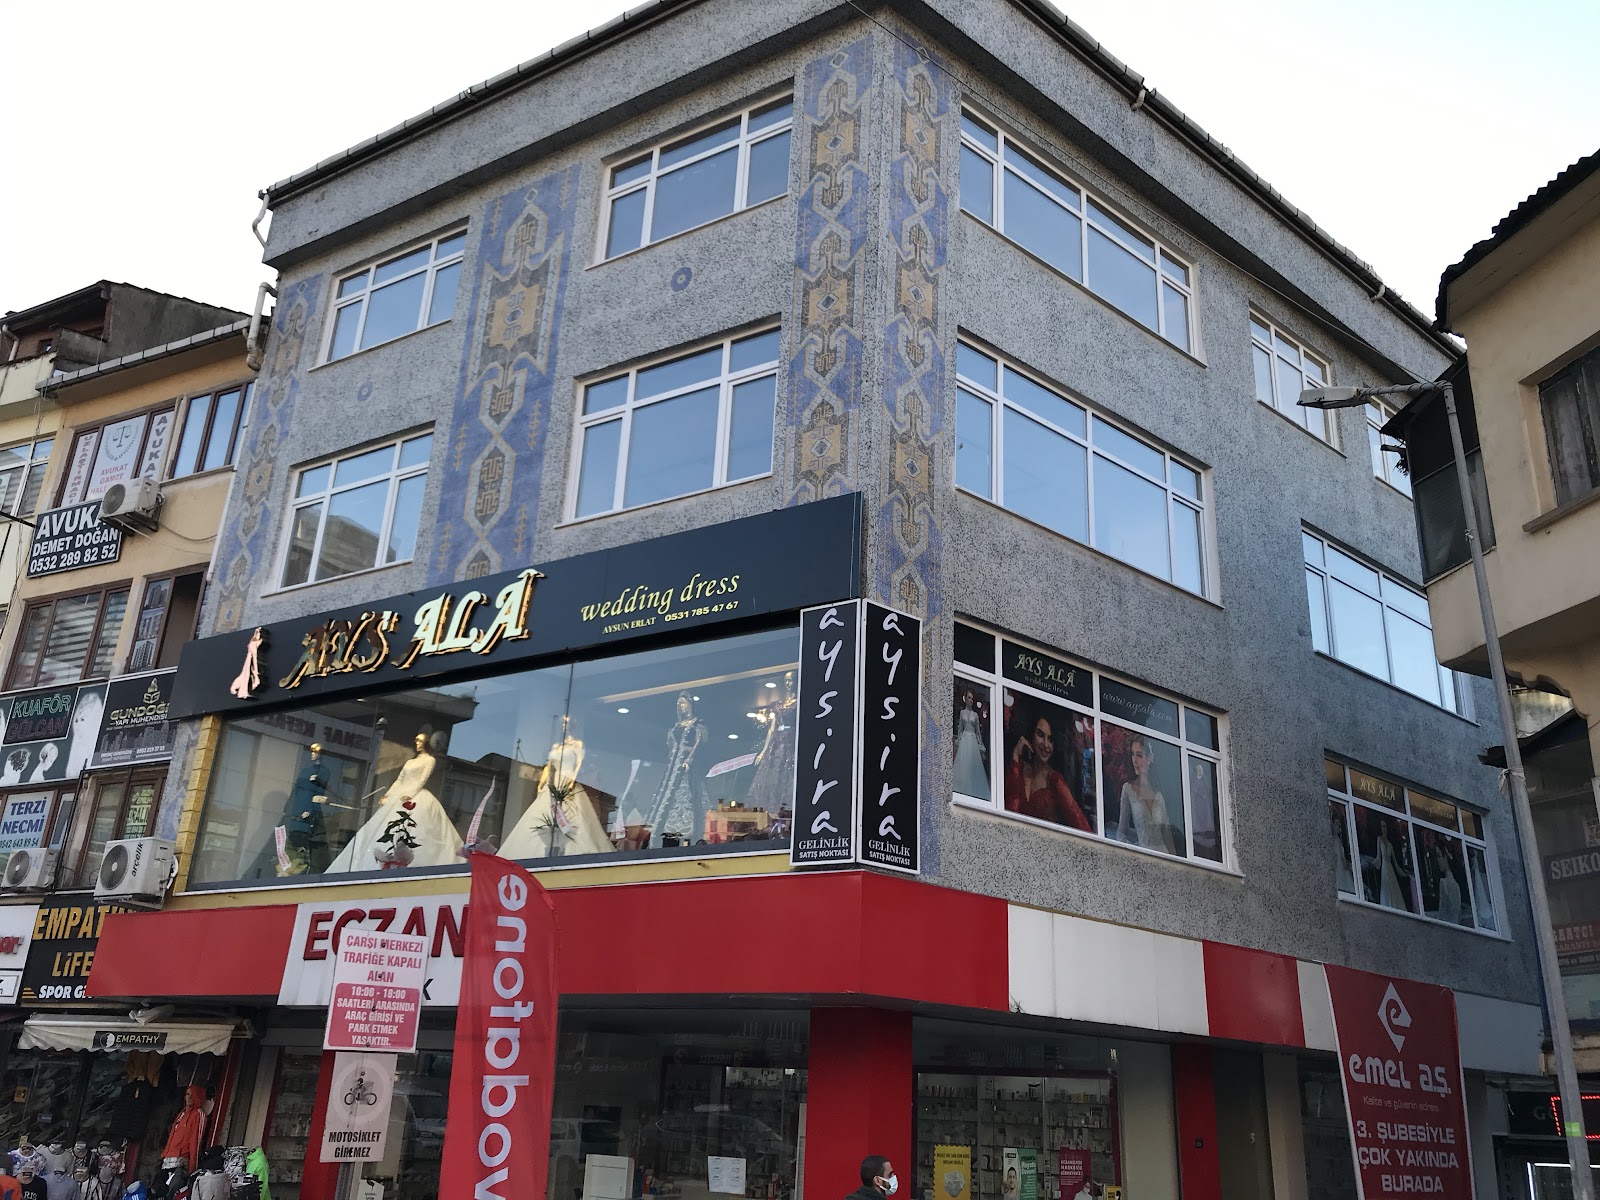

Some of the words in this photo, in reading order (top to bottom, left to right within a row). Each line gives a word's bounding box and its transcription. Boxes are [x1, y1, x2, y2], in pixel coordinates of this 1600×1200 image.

[100, 463, 129, 476] AVUKAT
[100, 473, 125, 485] GAMZE
[32, 536, 73, 557] DEMET
[74, 526, 119, 549] DOĞAN
[30, 555, 58, 573] 0532
[59, 551, 81, 568] 289
[84, 547, 99, 562] 82
[101, 544, 117, 560] 52
[580, 584, 674, 622] wedding
[680, 573, 740, 603] dress
[602, 622, 630, 635] AYSUN
[630, 616, 657, 629] ERLAT
[664, 610, 689, 622] 0531
[691, 606, 710, 617] 785
[711, 603, 724, 613] 47
[726, 600, 739, 611] 67
[12, 694, 71, 718] KUAFÖR
[811, 607, 845, 834] aysira
[878, 612, 905, 840] aysira
[10, 796, 47, 815] TERZİ
[1, 815, 45, 834] NECMİ
[799, 836, 850, 849] GELİNLİK
[868, 840, 911, 857] GELİNLİK
[131, 842, 144, 877] arçelik
[799, 851, 818, 859] SATIŞ
[819, 849, 849, 857] NOKTASI
[869, 850, 886, 862] SATIŞ
[886, 854, 911, 866] NOKTASI
[1551, 852, 1600, 880] SEIKO
[32, 904, 137, 940] EMPAT
[346, 935, 378, 950] ÇARŞI
[380, 939, 424, 953] MERKEZİ
[343, 951, 385, 966] TRAFİĞE
[387, 955, 422, 969] KAPALI
[367, 970, 394, 983] ALAN
[39, 985, 72, 999] SPOR
[351, 985, 375, 997] 10:00
[383, 988, 406, 999] 18:00
[336, 998, 375, 1009] SAATLERİ
[375, 1001, 415, 1012] ARASINDA
[344, 1010, 367, 1022] ARAÇ
[368, 1011, 393, 1023] GİRİŞİ
[394, 1013, 405, 1023] VE
[347, 1022, 371, 1033] PARK
[371, 1024, 399, 1035] ETMEK
[115, 1033, 160, 1044] EMPATHY
[351, 1035, 392, 1046] YASAKTIR.
[1349, 1053, 1412, 1089] emel
[328, 1129, 382, 1143] MOTOSİKLET
[1356, 1120, 1372, 1138] 3.
[1376, 1121, 1456, 1144] ŞUBESİYLE
[334, 1145, 371, 1158] GİREMEZ
[1357, 1146, 1393, 1169] ÇOK
[1395, 1148, 1460, 1168] YAKINDA
[1381, 1174, 1445, 1192] BURADA
